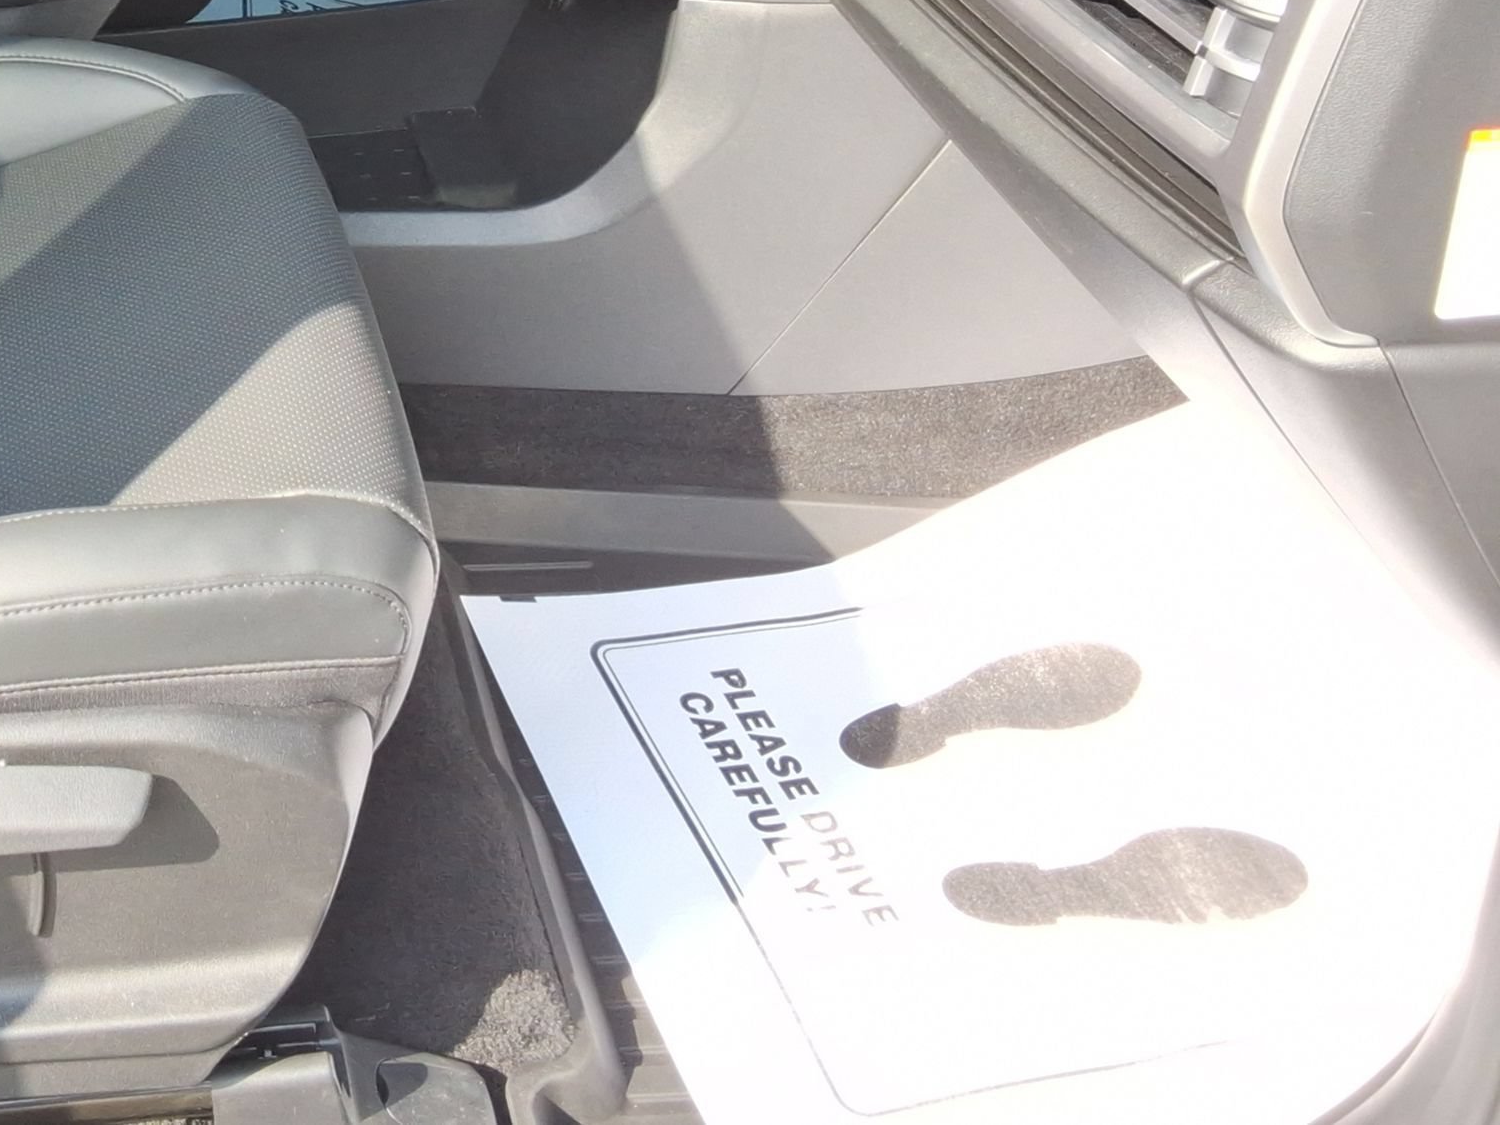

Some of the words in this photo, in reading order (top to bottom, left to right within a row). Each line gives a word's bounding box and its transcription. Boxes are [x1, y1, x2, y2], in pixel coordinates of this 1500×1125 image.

[679, 691, 837, 913] CAREFULLY!
[710, 667, 821, 801] PLEASE
[800, 810, 899, 927] DRIVE
